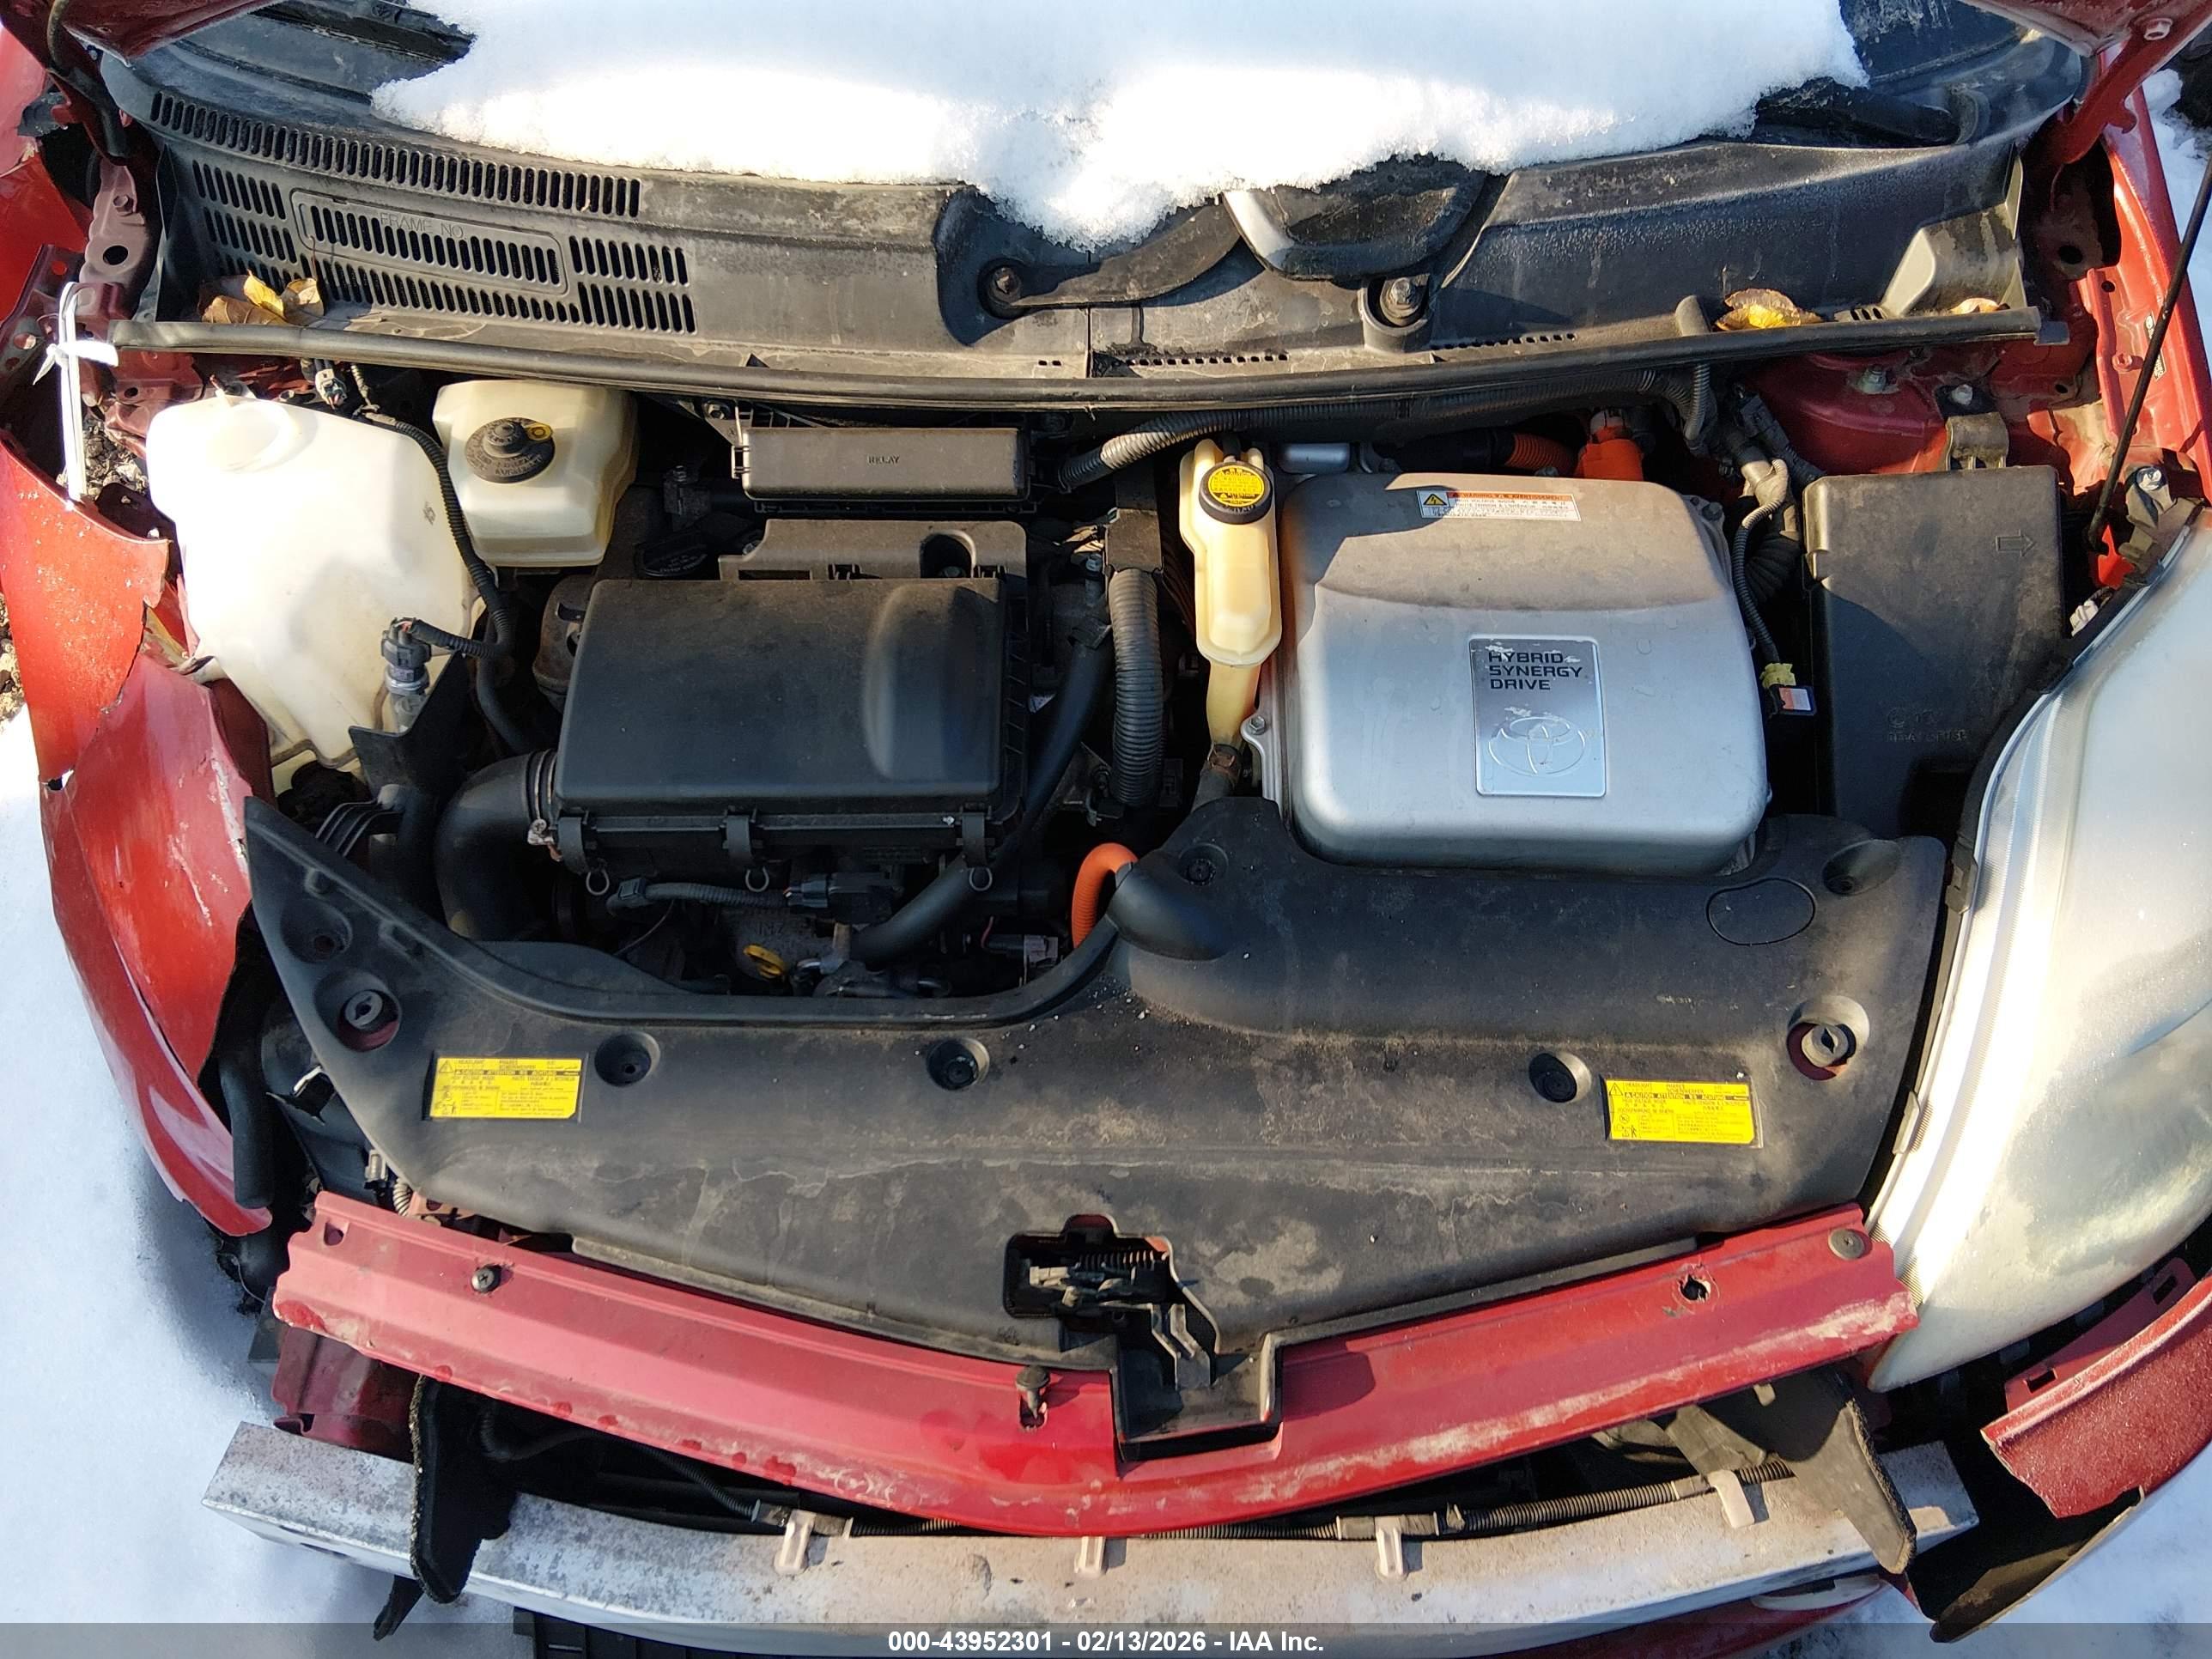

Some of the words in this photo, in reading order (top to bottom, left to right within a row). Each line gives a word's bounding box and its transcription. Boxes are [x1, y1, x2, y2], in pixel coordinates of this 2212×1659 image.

[380, 212, 434, 234] FRAME
[867, 455, 901, 465] RELAY
[1488, 652, 1564, 664] HYBRID
[1489, 665, 1583, 678] SYNERGY
[1490, 678, 1551, 690] DRIVE
